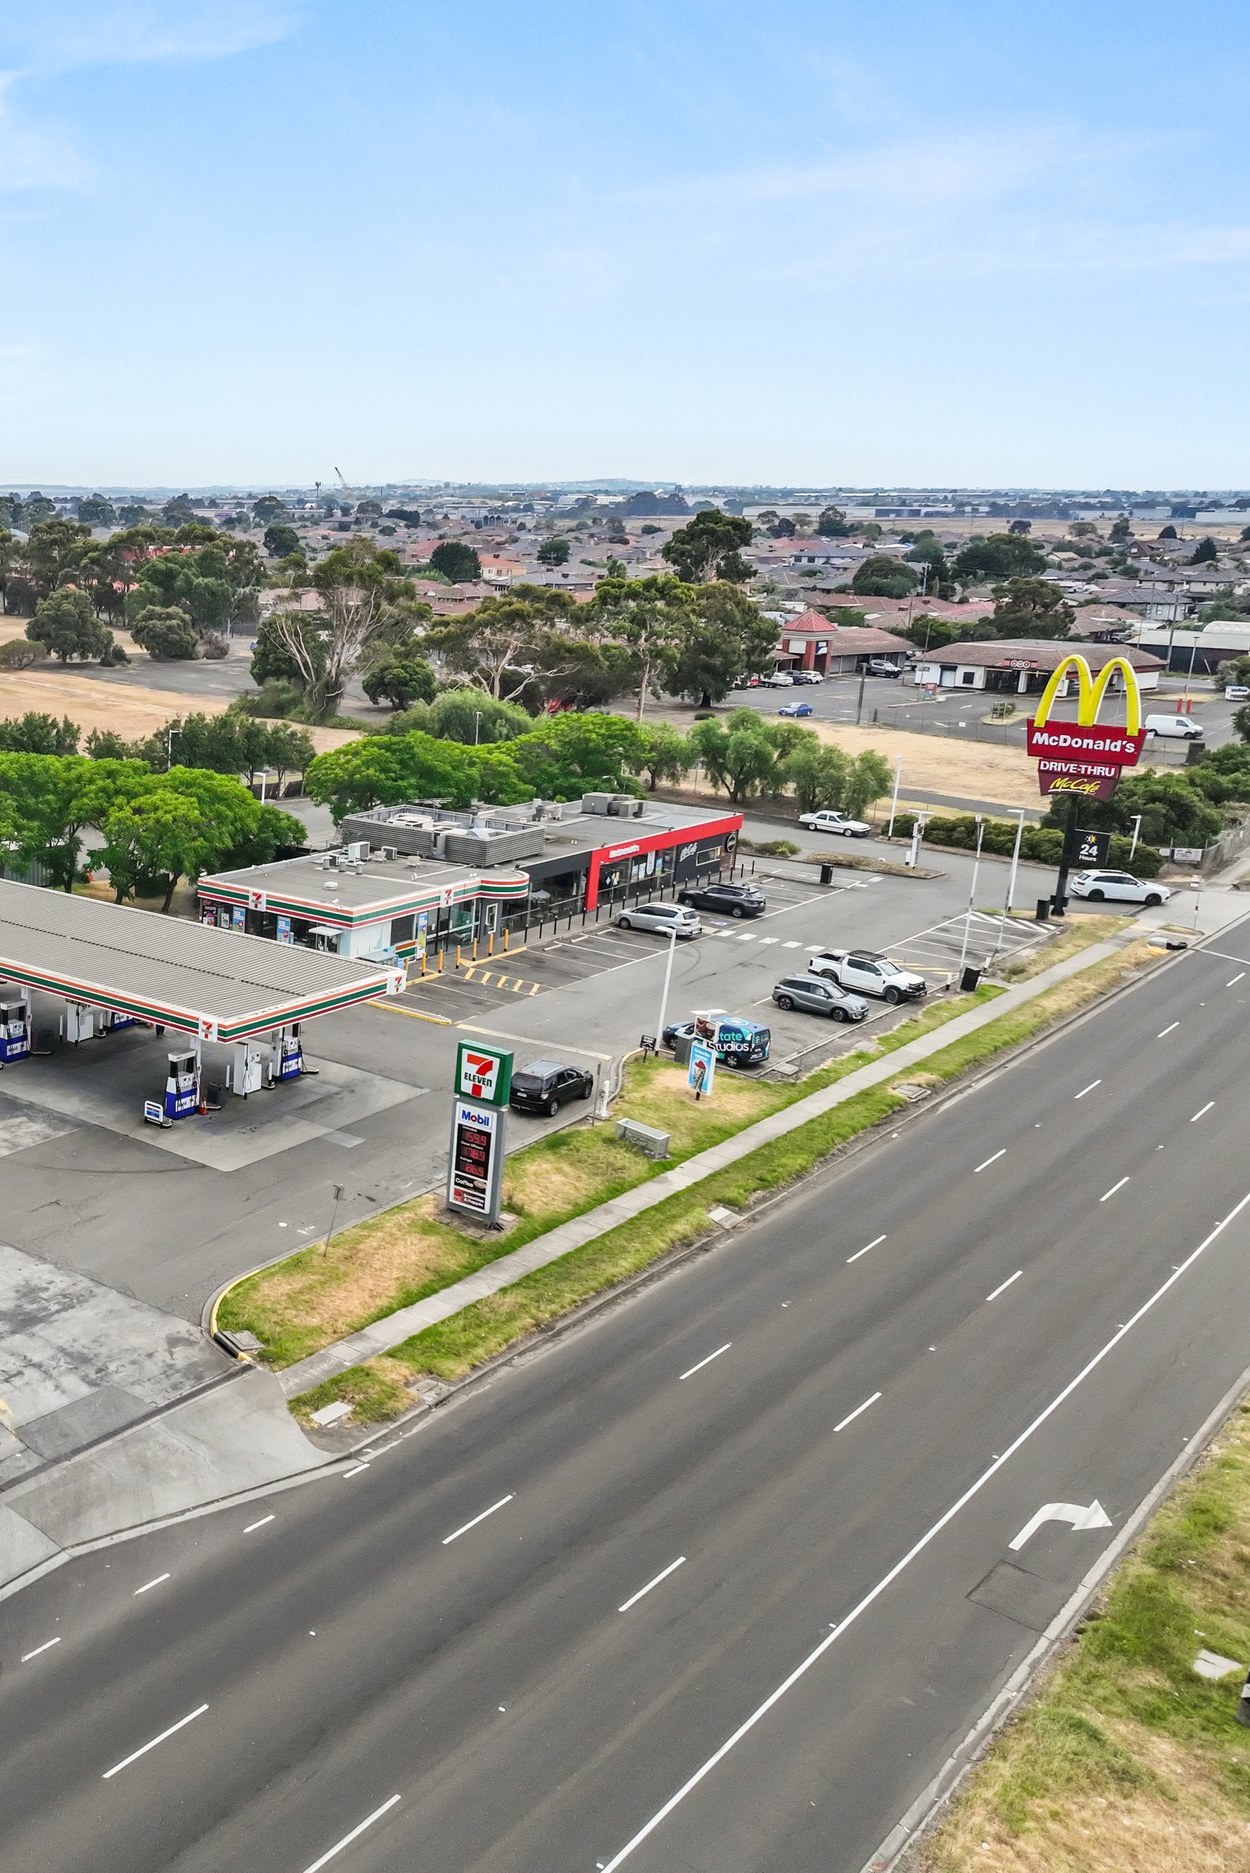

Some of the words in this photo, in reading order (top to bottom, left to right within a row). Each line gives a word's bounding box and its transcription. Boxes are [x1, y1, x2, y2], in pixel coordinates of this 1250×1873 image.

[1032, 732, 1136, 753] McDonald's
[1040, 761, 1116, 778] DRIVE-THRU
[1080, 843, 1098, 856] 24
[1078, 854, 1097, 863] Hours
[709, 1041, 749, 1052] Studios
[466, 1053, 493, 1098] 7
[461, 1109, 490, 1127] Mobil
[455, 1177, 474, 1188] Coffee
